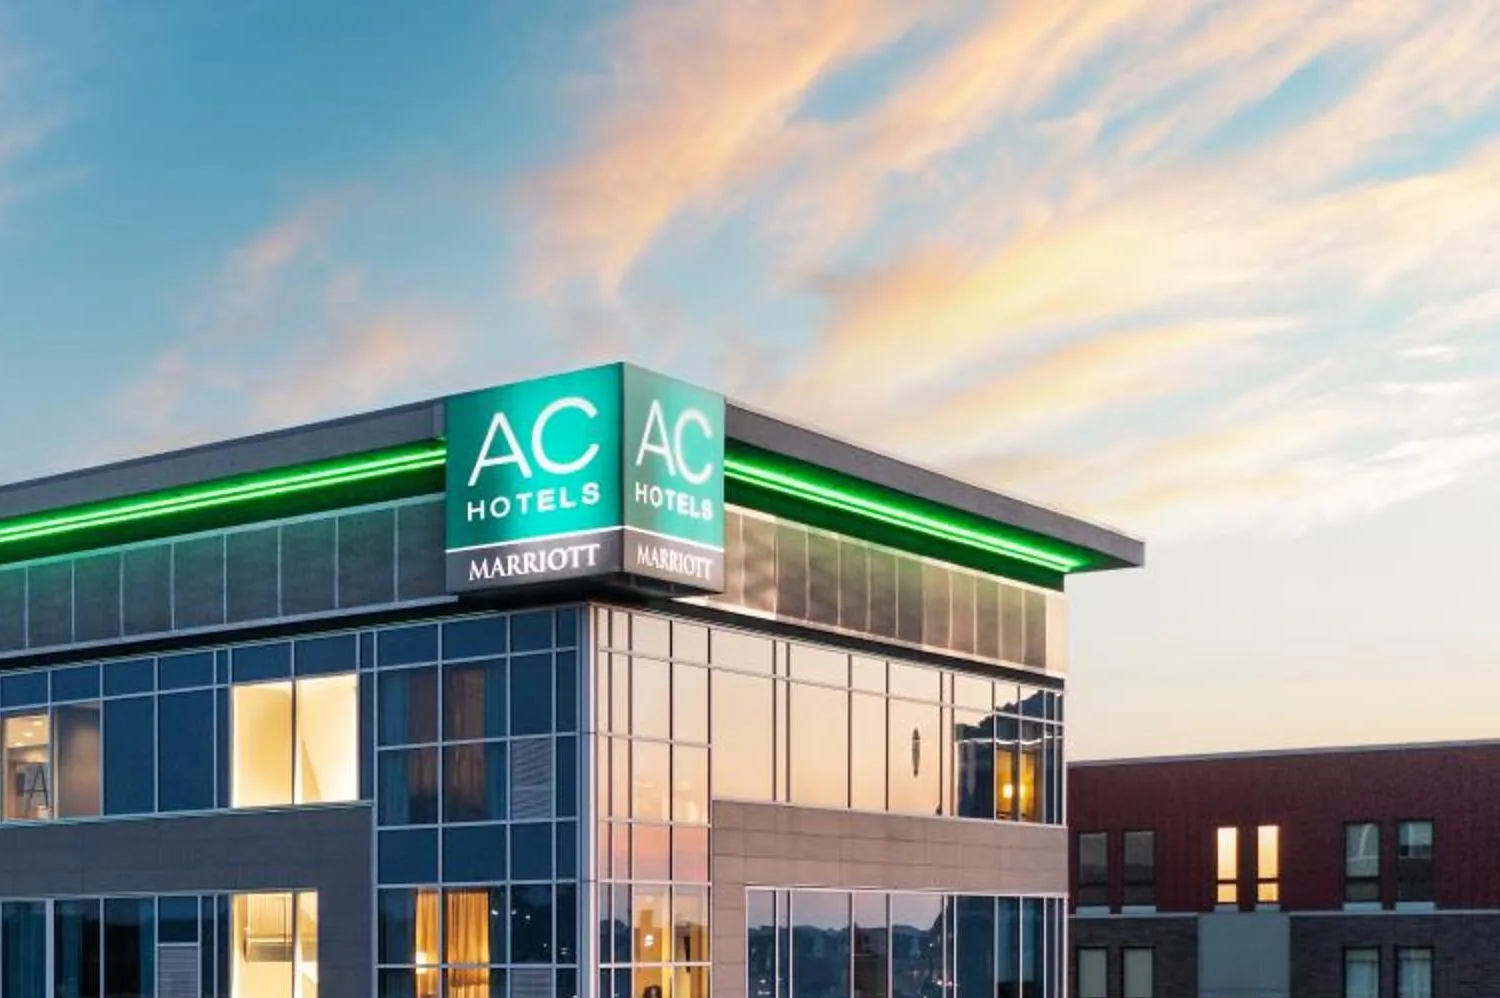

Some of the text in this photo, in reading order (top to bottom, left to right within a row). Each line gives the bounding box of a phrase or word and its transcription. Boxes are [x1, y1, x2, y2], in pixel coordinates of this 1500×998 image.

[467, 397, 600, 487] AC
[636, 399, 714, 485] AC
[466, 482, 601, 522] HOTELS
[635, 481, 714, 521] HOTELS
[468, 543, 601, 581] MARRIOTT
[637, 544, 714, 581] MARRIOTT
